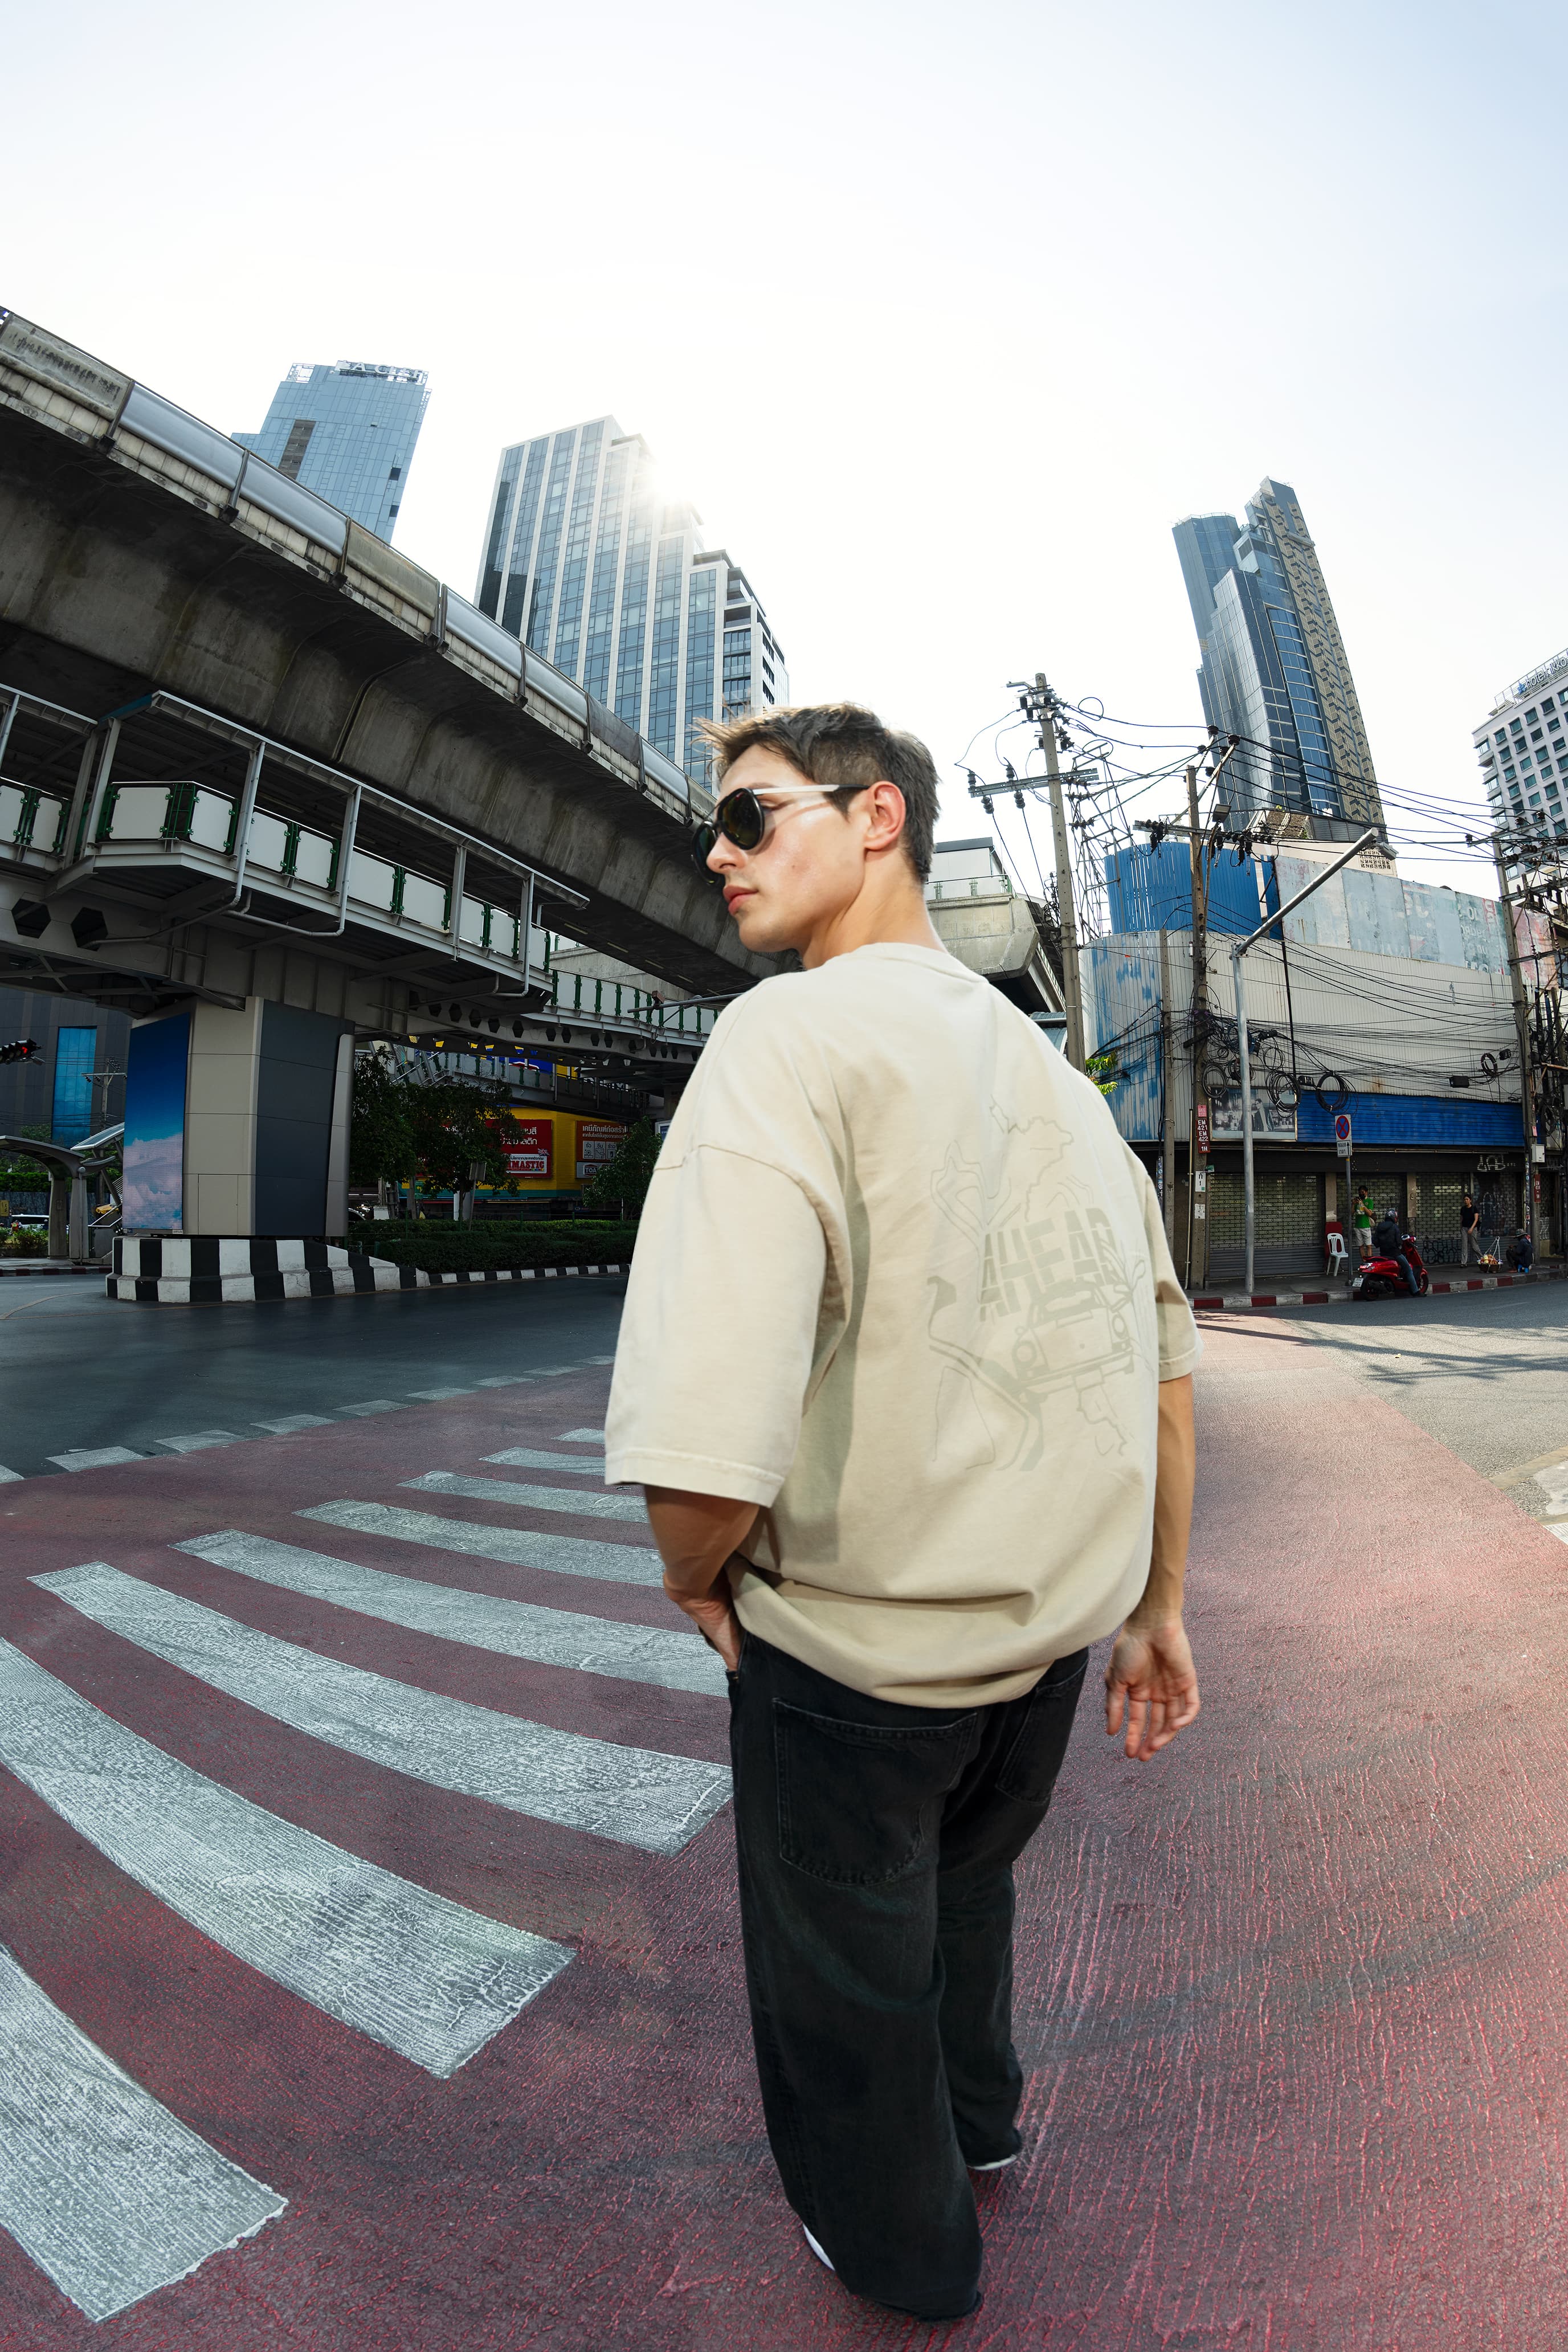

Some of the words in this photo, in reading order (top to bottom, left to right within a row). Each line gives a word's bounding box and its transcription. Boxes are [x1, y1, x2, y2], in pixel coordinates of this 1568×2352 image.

[374, 364, 423, 378] CLEF
[1525, 667, 1546, 689] hotel
[979, 1206, 1127, 1322] AHEAD
